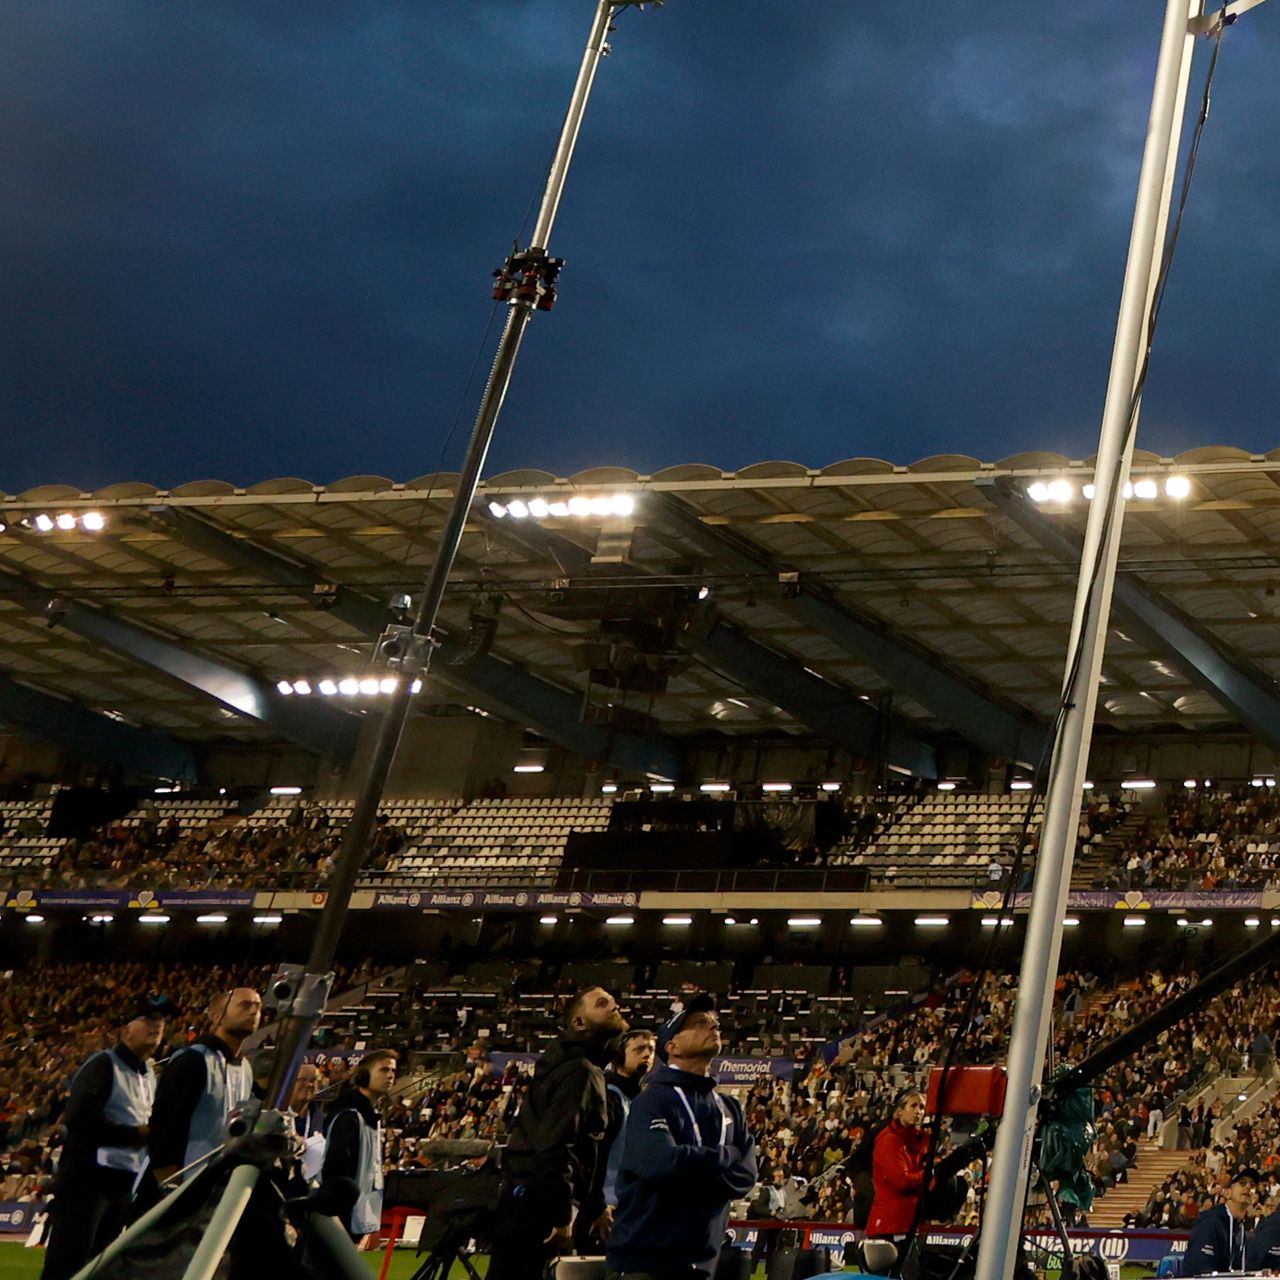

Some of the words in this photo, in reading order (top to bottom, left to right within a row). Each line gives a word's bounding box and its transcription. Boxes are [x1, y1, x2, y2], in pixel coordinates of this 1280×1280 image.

[315, 893, 323, 903] D
[378, 893, 408, 905] Allianz
[430, 893, 461, 905] Allianz
[484, 893, 515, 905] Allianz
[537, 893, 569, 905] Allianz
[591, 893, 622, 905] Allianz
[719, 1060, 771, 1072] Memorial
[926, 1234, 960, 1246] Allianz
